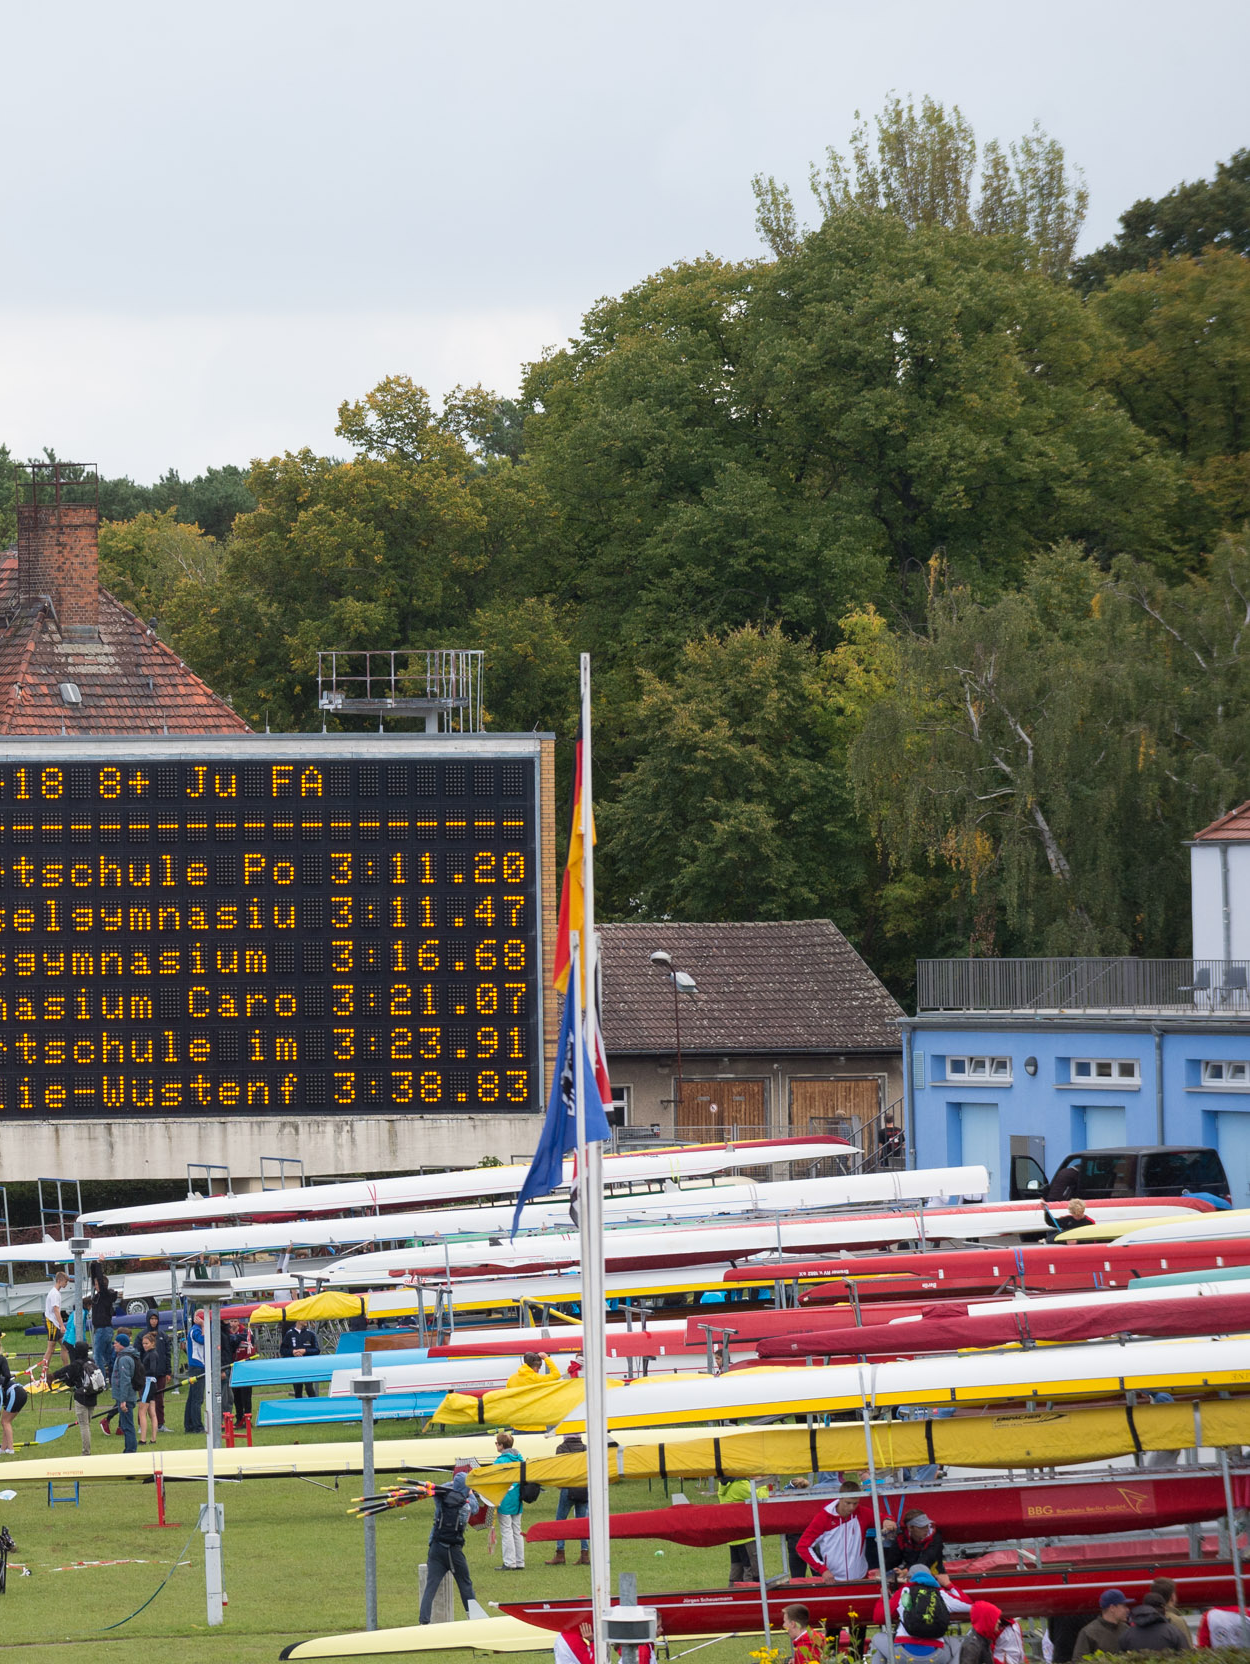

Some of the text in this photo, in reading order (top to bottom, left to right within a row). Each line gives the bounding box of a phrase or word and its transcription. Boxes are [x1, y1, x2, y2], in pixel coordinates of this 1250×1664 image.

[99, 767, 150, 799] 8+
[186, 766, 237, 798] Ju
[272, 765, 323, 797] FA
[244, 853, 295, 885] Po
[330, 851, 525, 884] 3:11.20
[330, 895, 525, 928] 3:11.47
[331, 939, 526, 972] 3:16.68
[188, 986, 297, 1018] Caro
[332, 983, 527, 1016] 3:21.07
[250, 1029, 298, 1061] im
[333, 1026, 523, 1060] 3:23.91
[333, 1070, 528, 1104] 3:38.83
[1027, 1505, 1054, 1516] BBG
